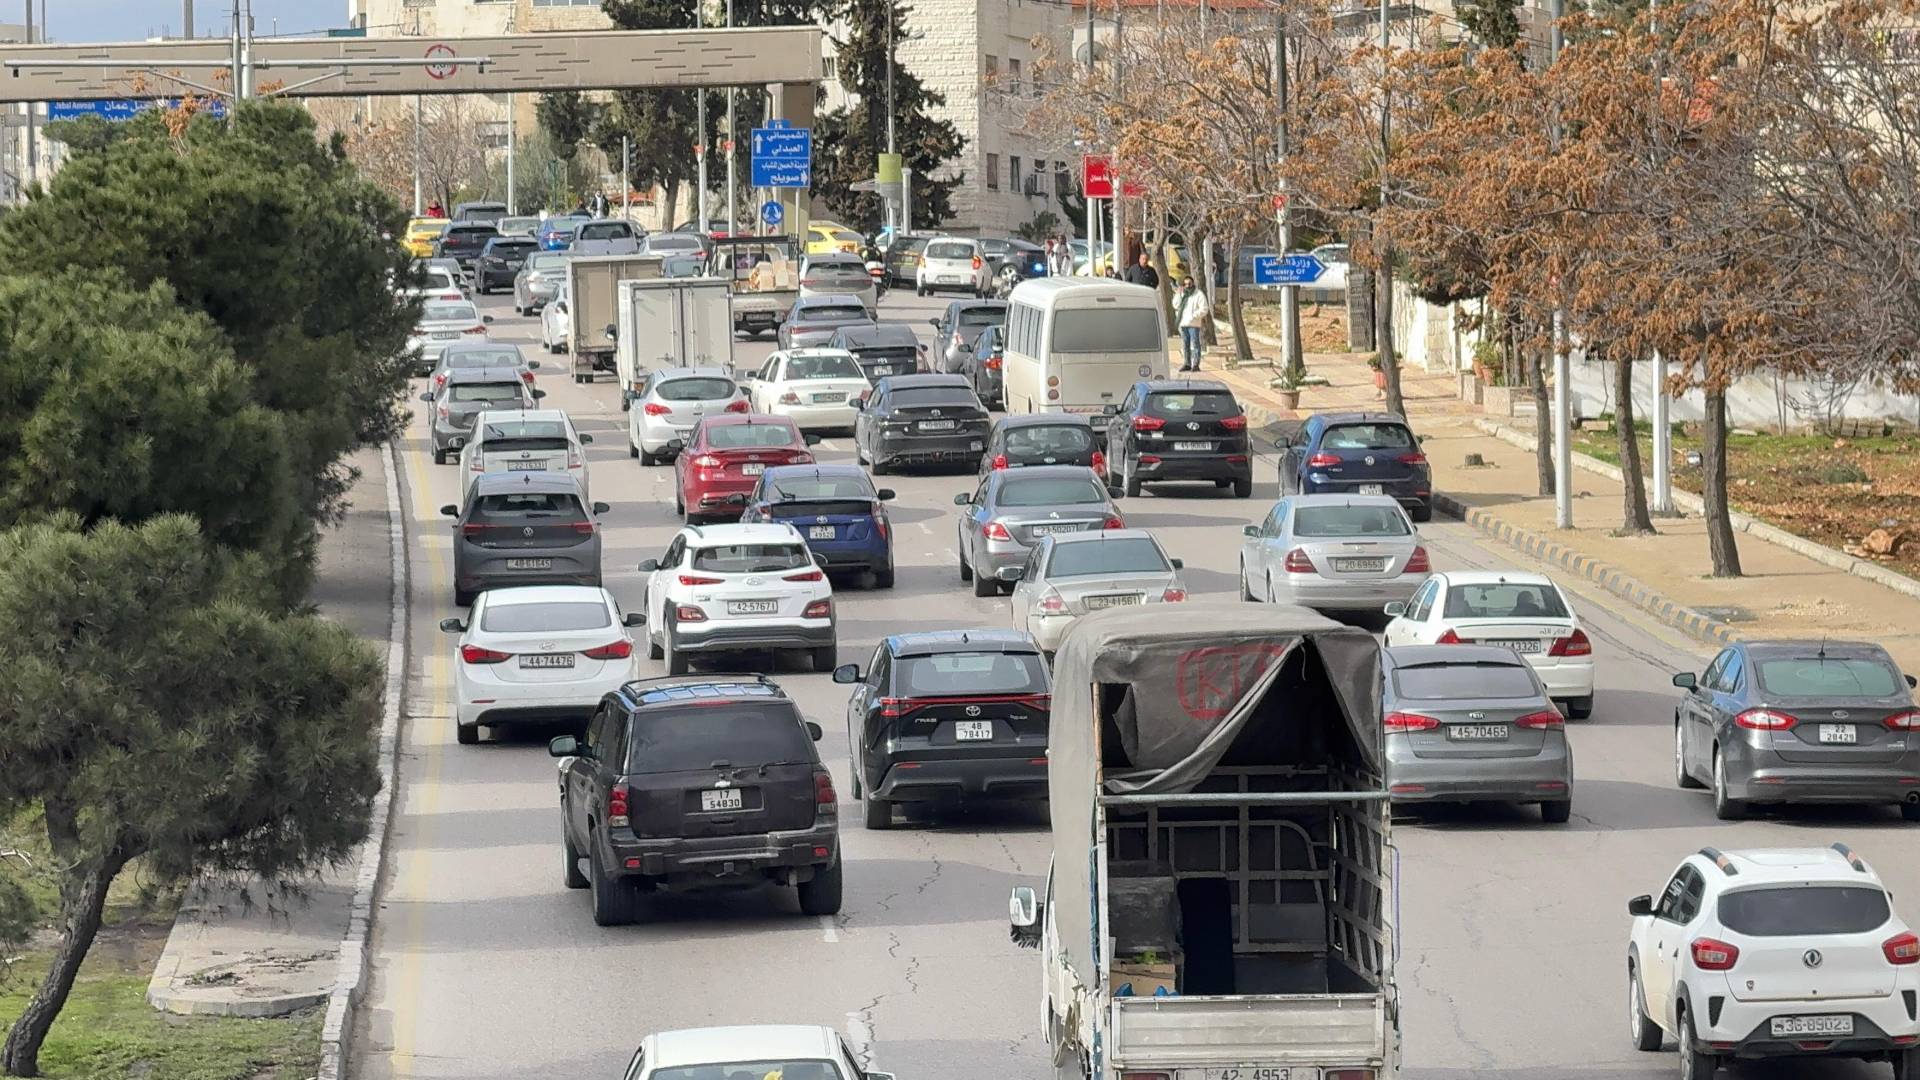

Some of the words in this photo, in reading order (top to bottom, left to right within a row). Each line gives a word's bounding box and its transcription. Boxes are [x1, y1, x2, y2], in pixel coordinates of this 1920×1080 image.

[1456, 727, 1507, 738] 45-70465
[719, 790, 730, 799] 17
[710, 799, 740, 808] 54830
